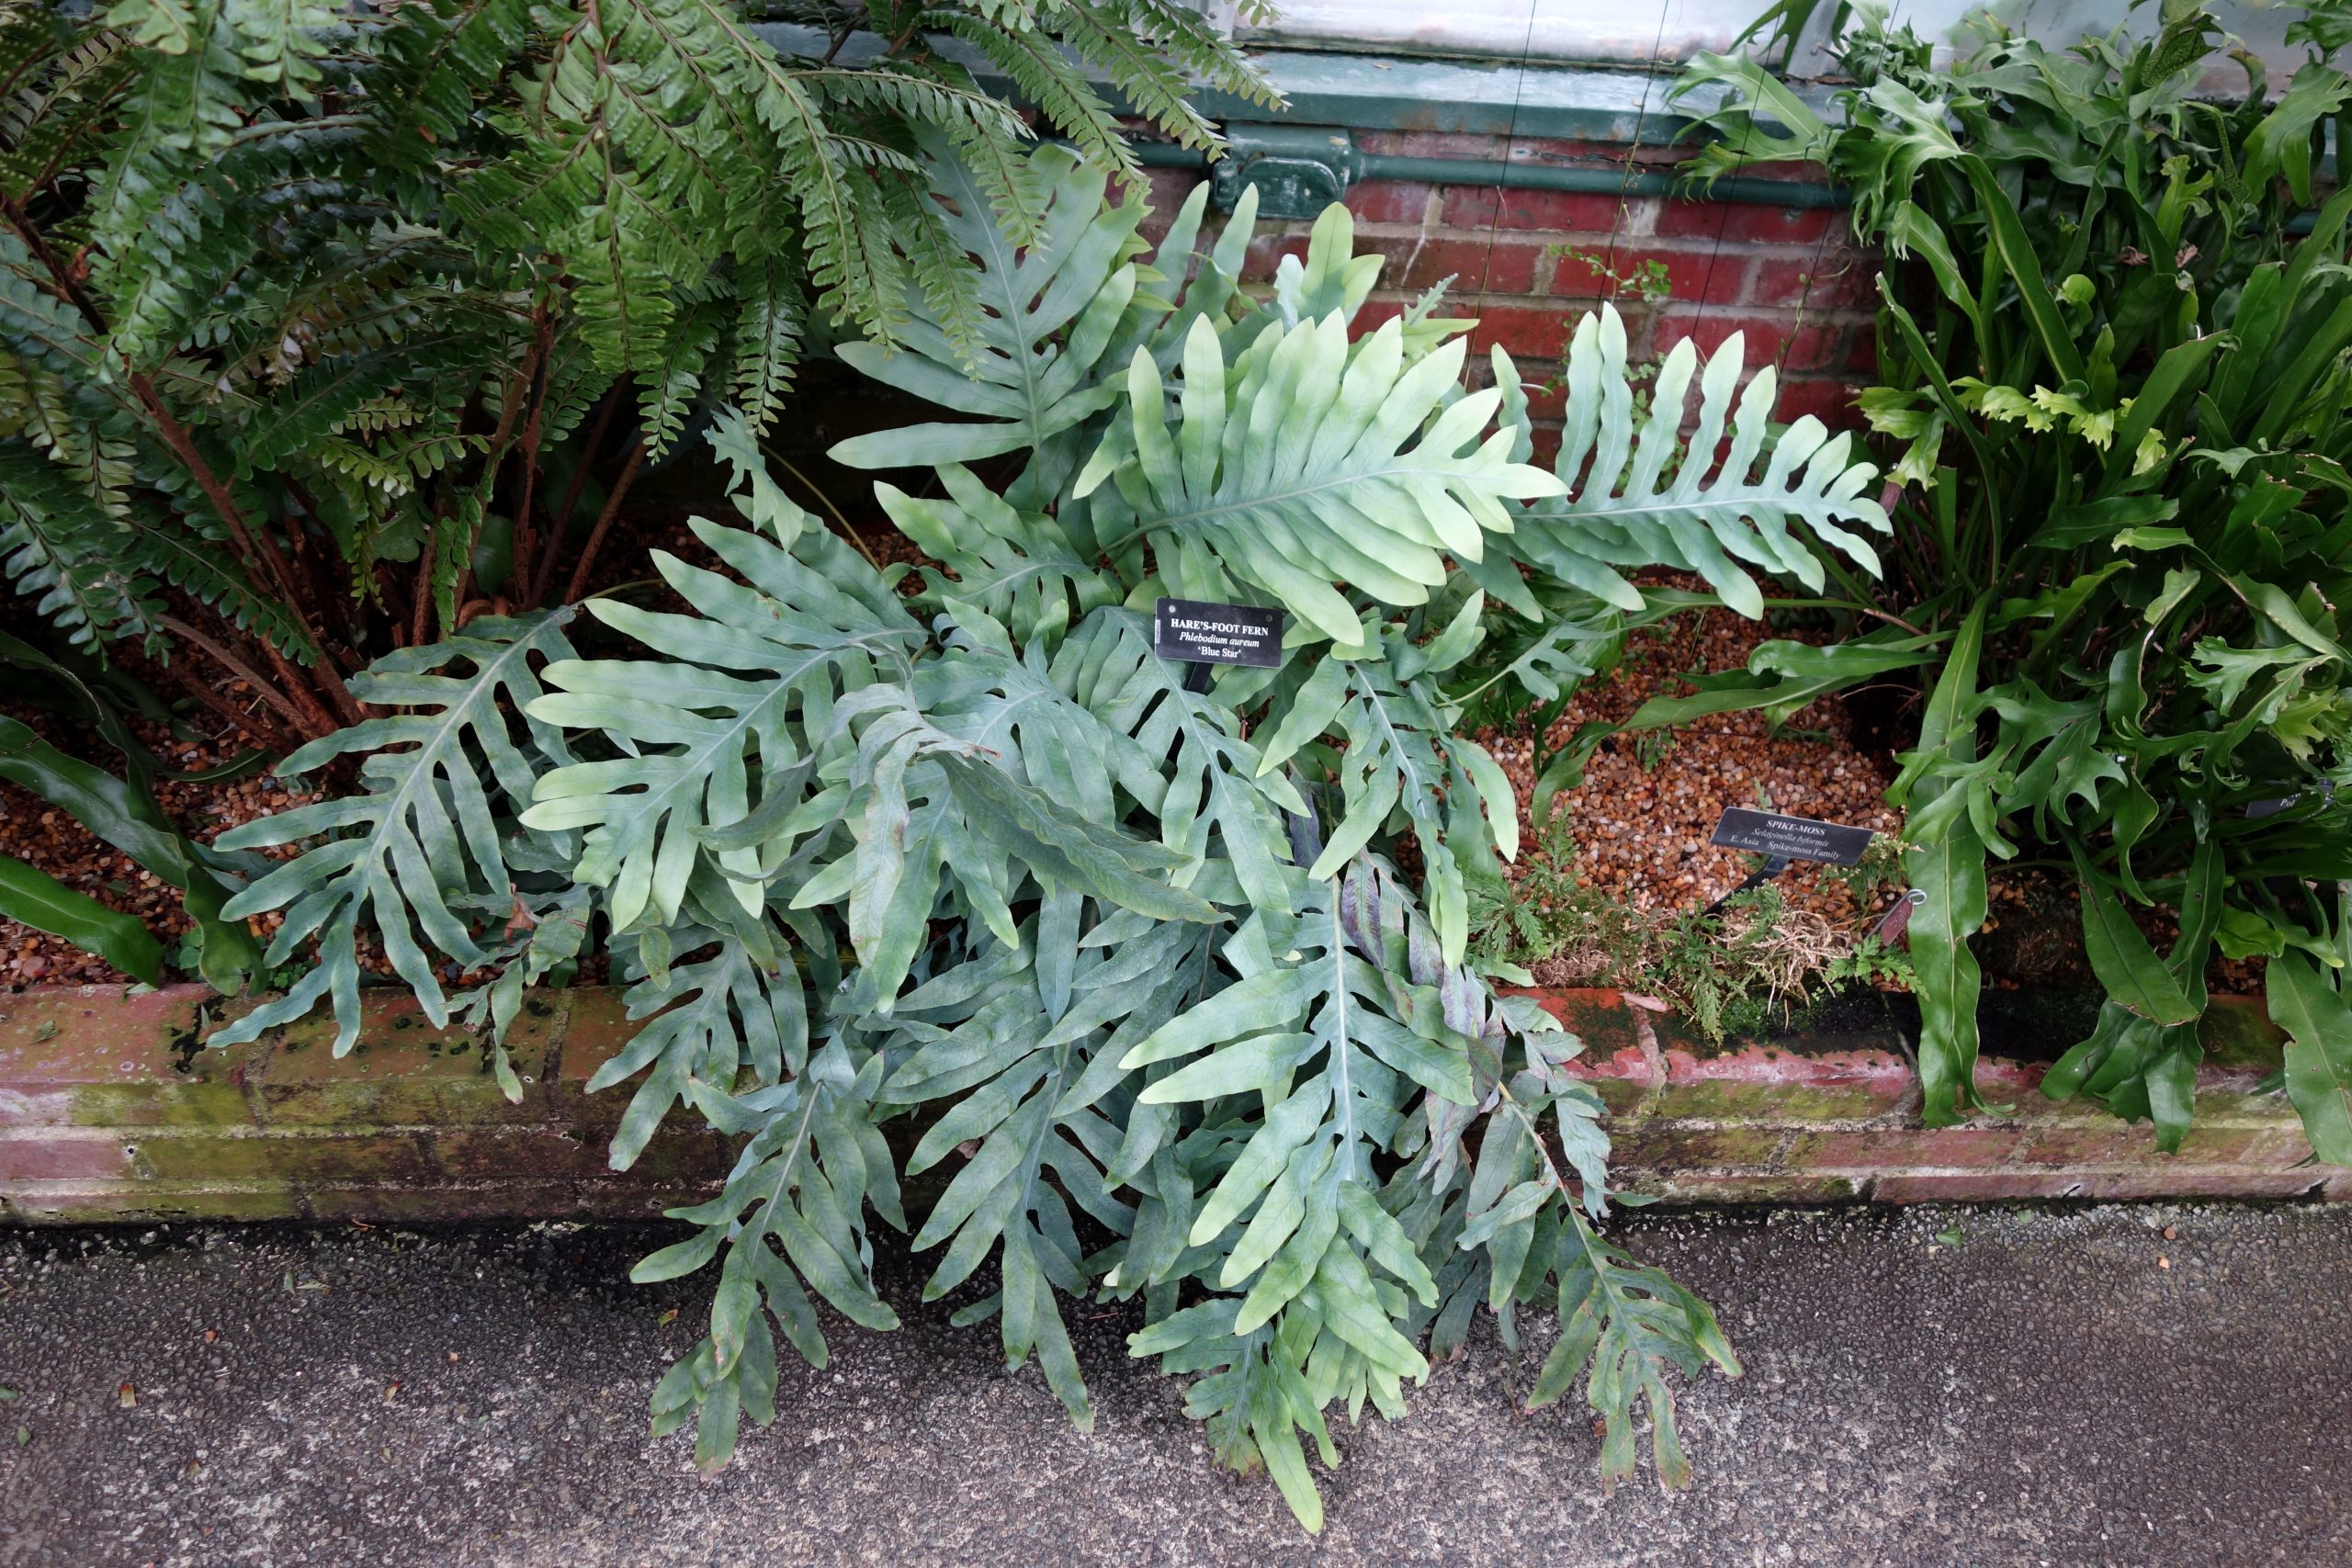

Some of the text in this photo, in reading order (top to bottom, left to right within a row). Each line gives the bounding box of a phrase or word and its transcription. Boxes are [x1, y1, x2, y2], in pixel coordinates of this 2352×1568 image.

[1170, 618, 1269, 637] HARE’S-FOOT FERN
[1179, 631, 1260, 648] Phlebodium aureum
[1198, 646, 1241, 658] ‘Blue Star’
[1766, 819, 1826, 836] SPIKE-MOSS
[1751, 828, 1830, 847] Selaginella biformis
[1740, 837, 1759, 846] Asia
[1768, 840, 1812, 854] Spike-moss
[1813, 849, 1841, 860] Family
